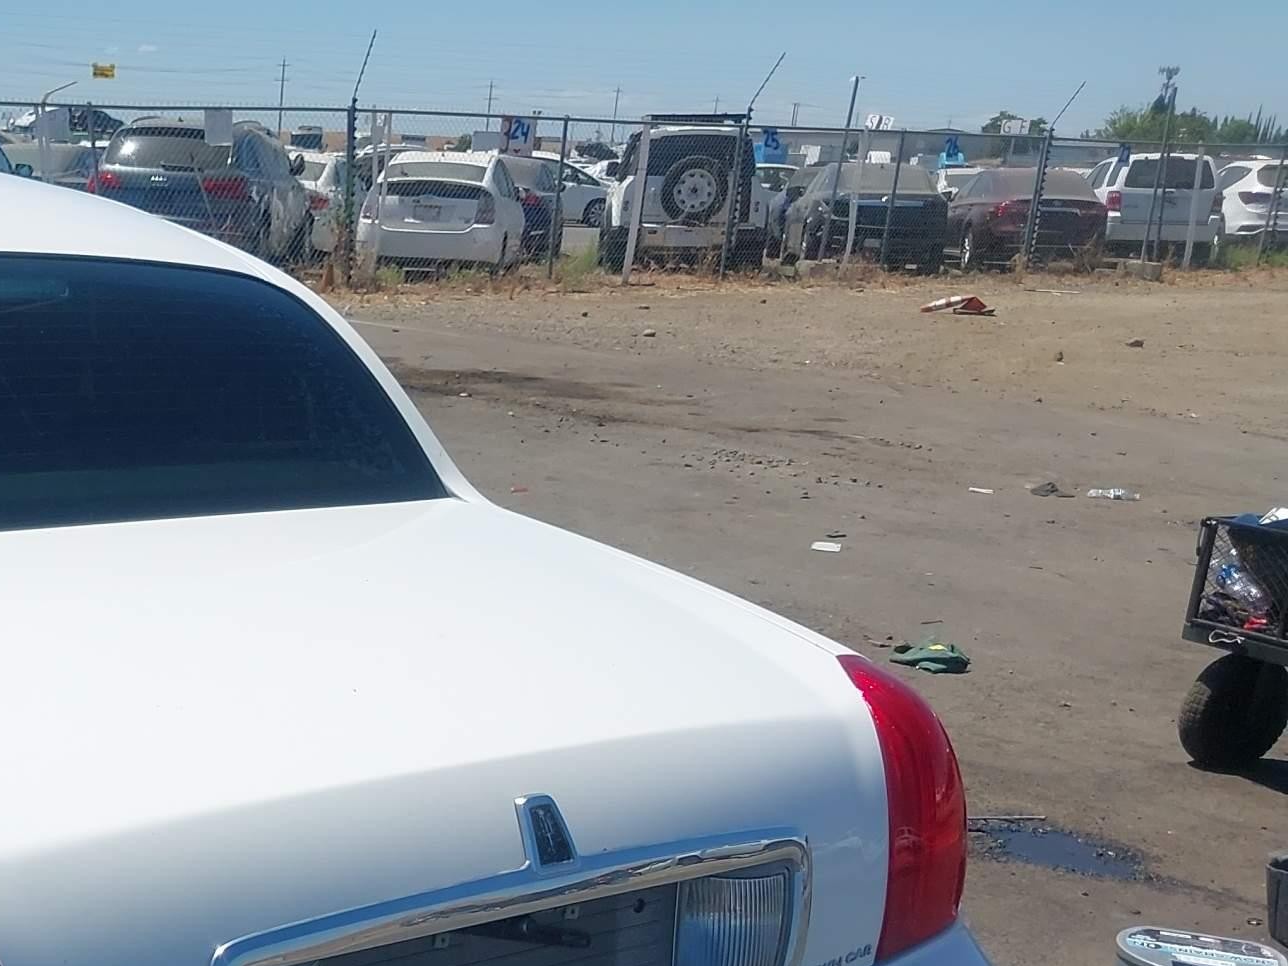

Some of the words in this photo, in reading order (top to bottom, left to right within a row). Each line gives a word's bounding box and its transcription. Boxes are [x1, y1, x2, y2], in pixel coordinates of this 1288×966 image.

[510, 120, 530, 144] 24
[763, 129, 781, 150] 25
[845, 943, 872, 964] CAR
